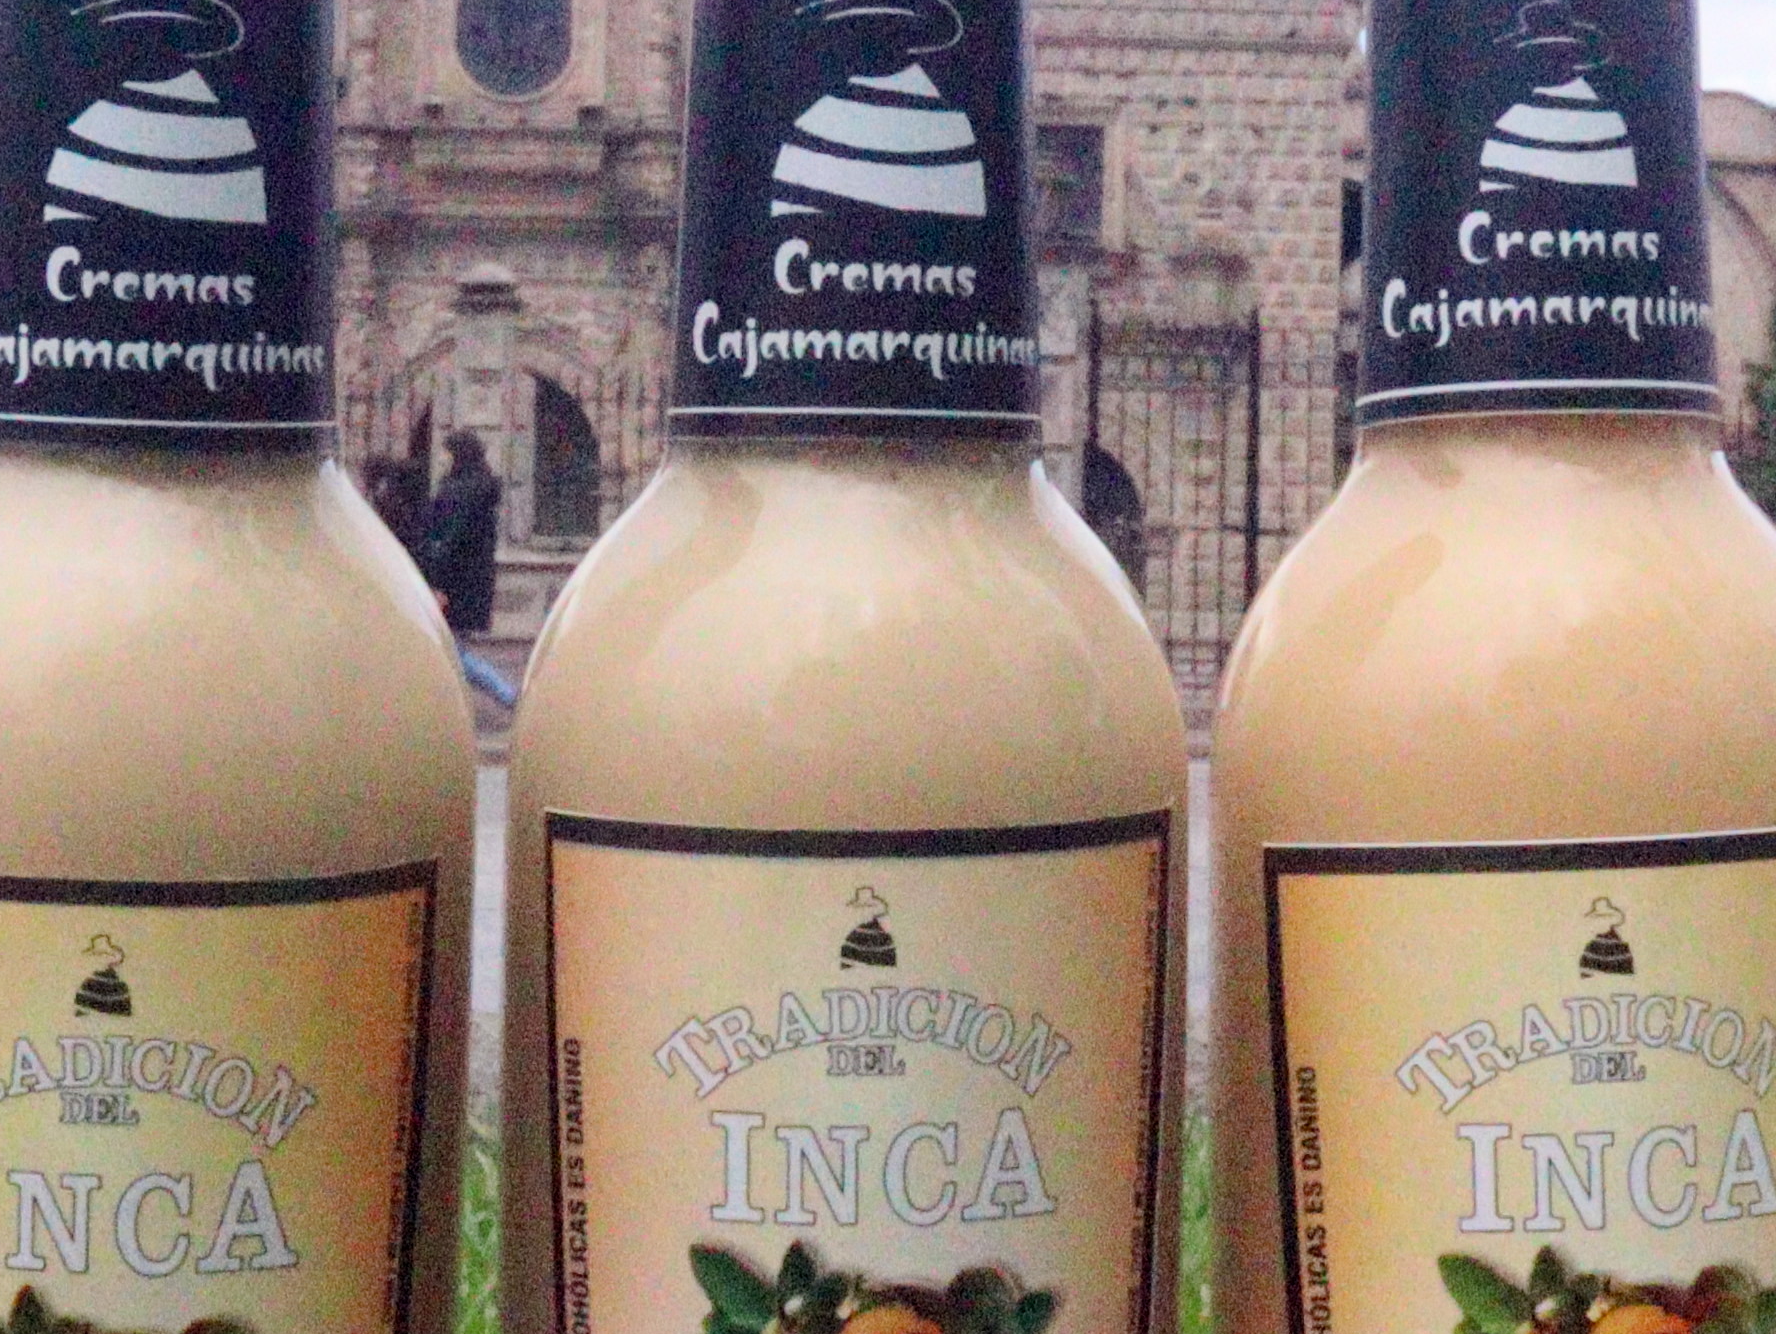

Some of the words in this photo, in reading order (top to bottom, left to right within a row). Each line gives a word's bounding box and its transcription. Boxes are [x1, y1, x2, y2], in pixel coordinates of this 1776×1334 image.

[1458, 210, 1660, 265] Cremas
[47, 246, 256, 304] Cremas
[774, 239, 976, 297] Cremas
[653, 986, 1073, 1100] TRADICION
[827, 1045, 907, 1076] DEL
[1572, 1051, 1647, 1084] DEL
[60, 1092, 140, 1125] DEL
[567, 1156, 585, 1190] ES
[710, 1106, 1059, 1228] INCA
[1303, 1181, 1323, 1214] ES
